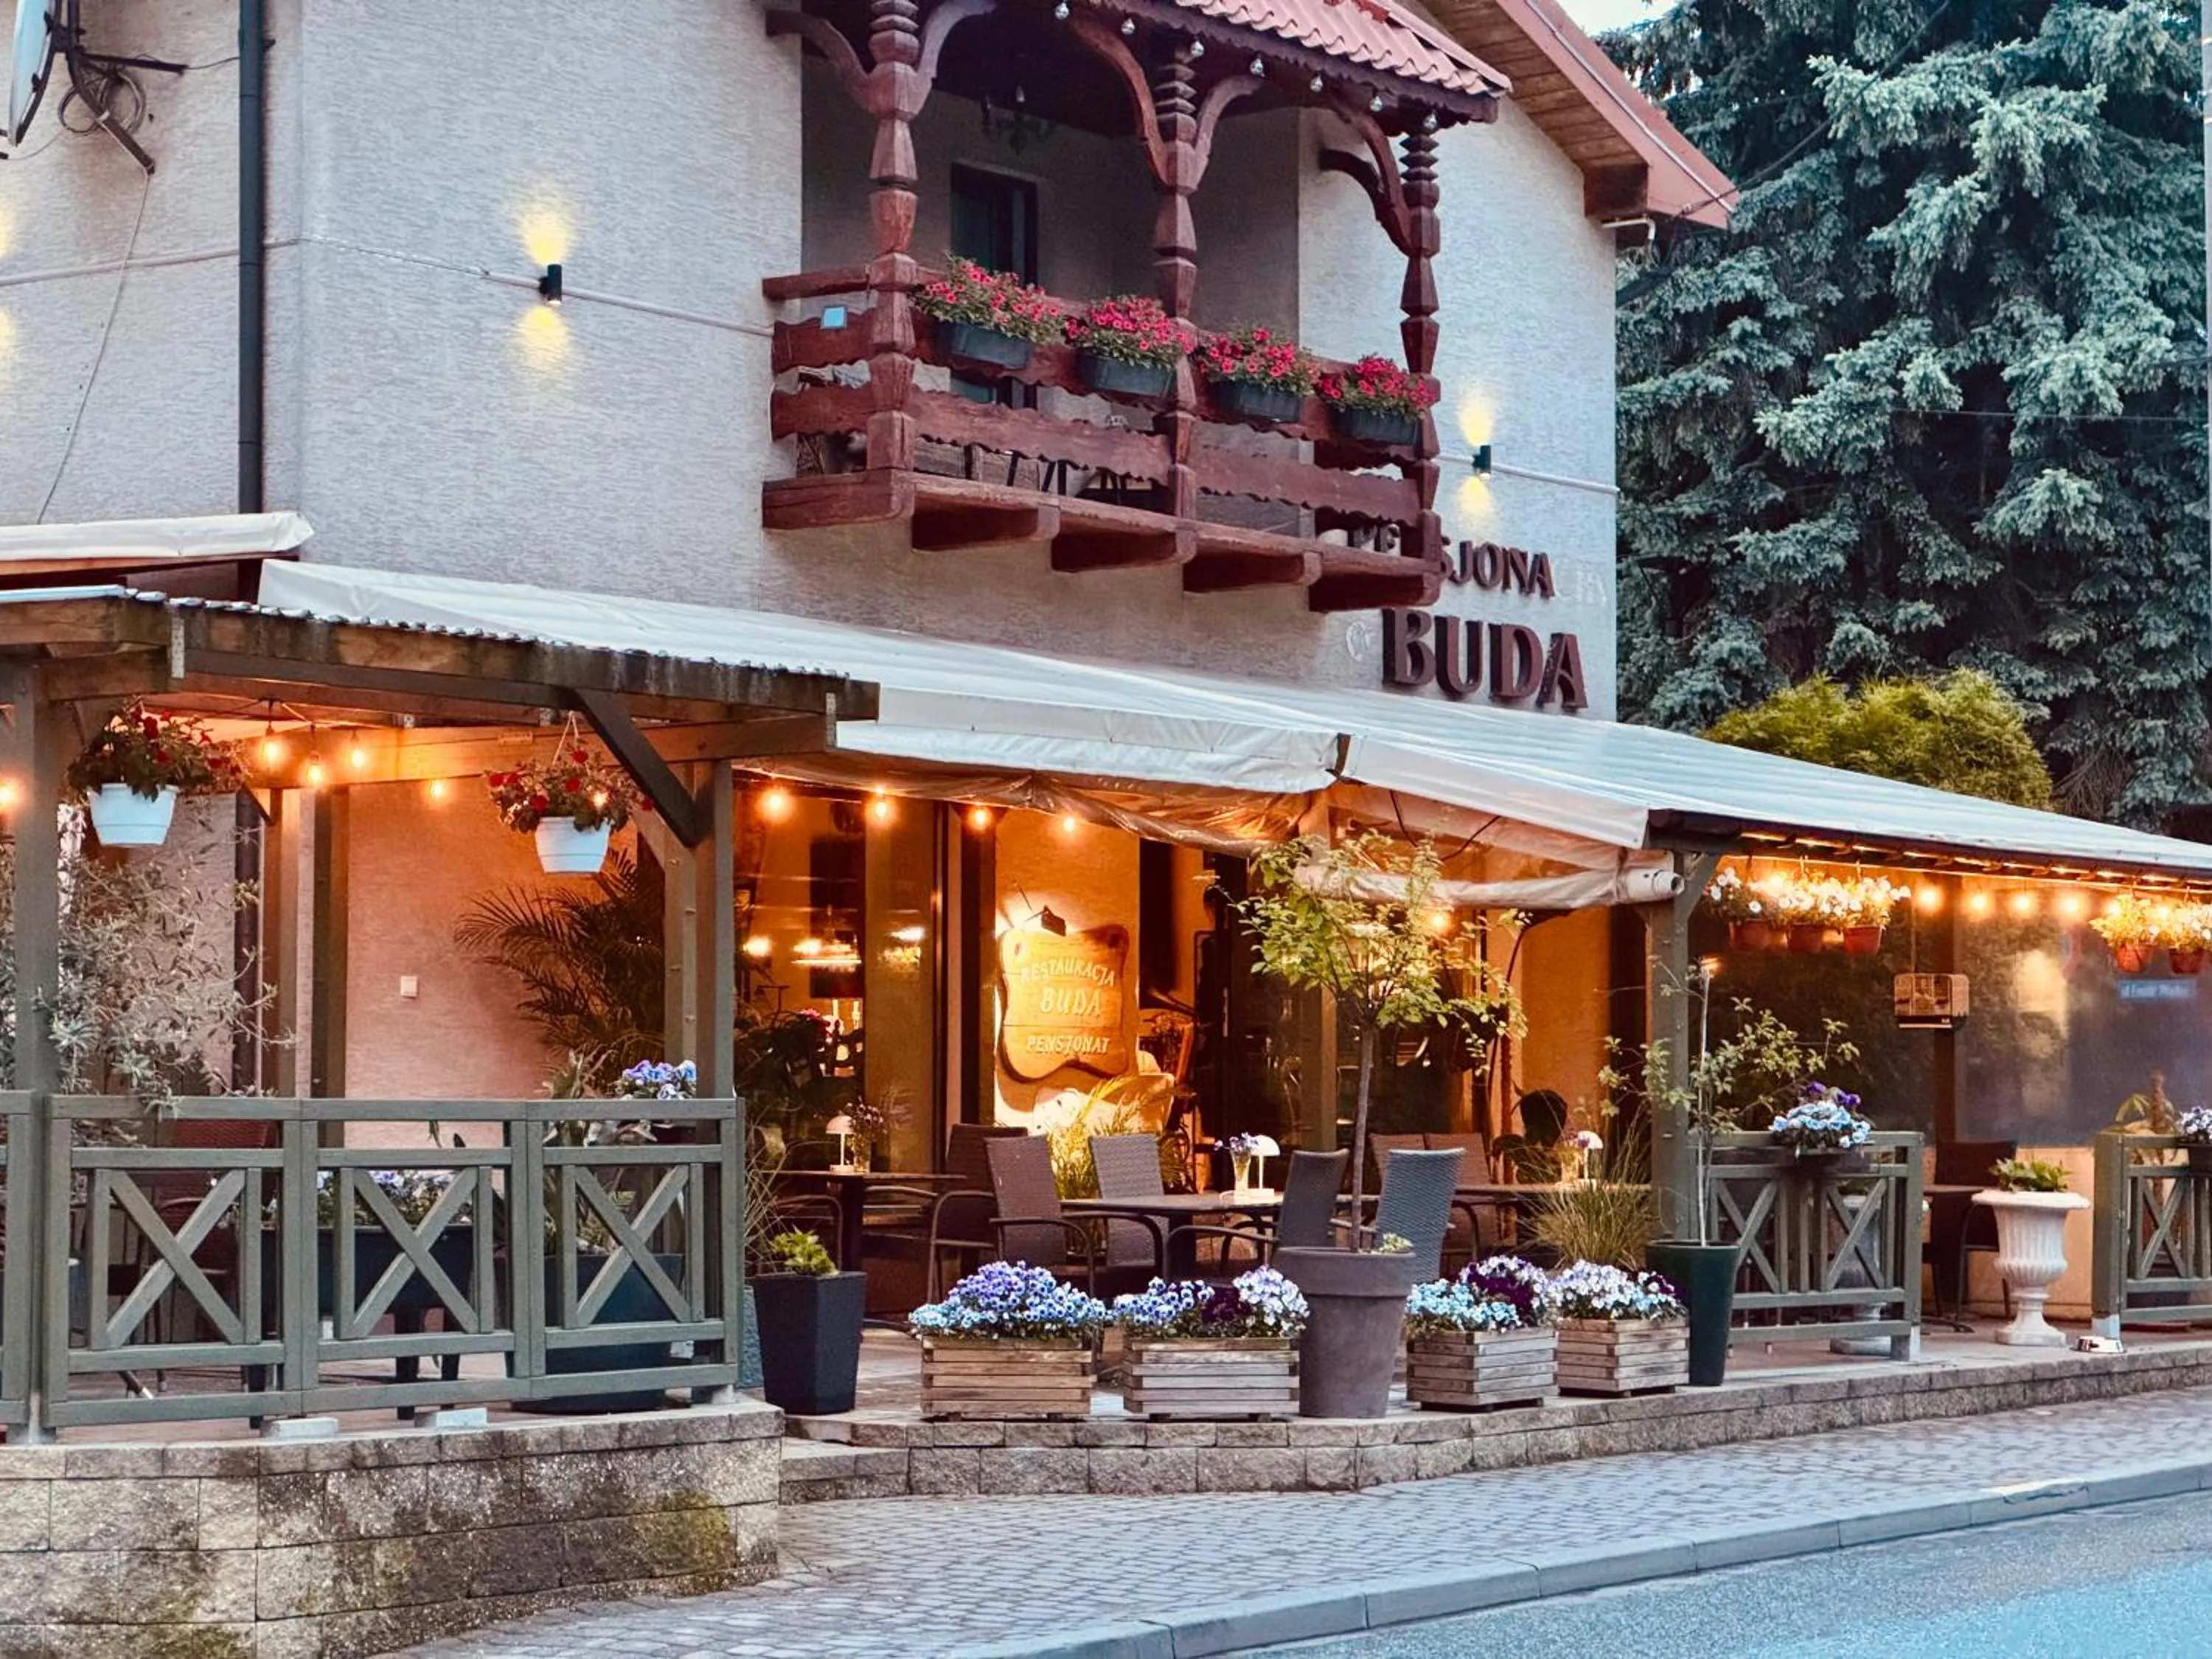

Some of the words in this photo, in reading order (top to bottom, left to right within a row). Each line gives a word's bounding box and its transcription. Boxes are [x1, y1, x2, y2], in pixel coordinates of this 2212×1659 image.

[1382, 608, 1588, 709] BUDA
[1021, 957, 1115, 987] RESTAURACJA
[1040, 987, 1101, 1016] BUDA
[1026, 1034, 1110, 1054] PENSJONAT
